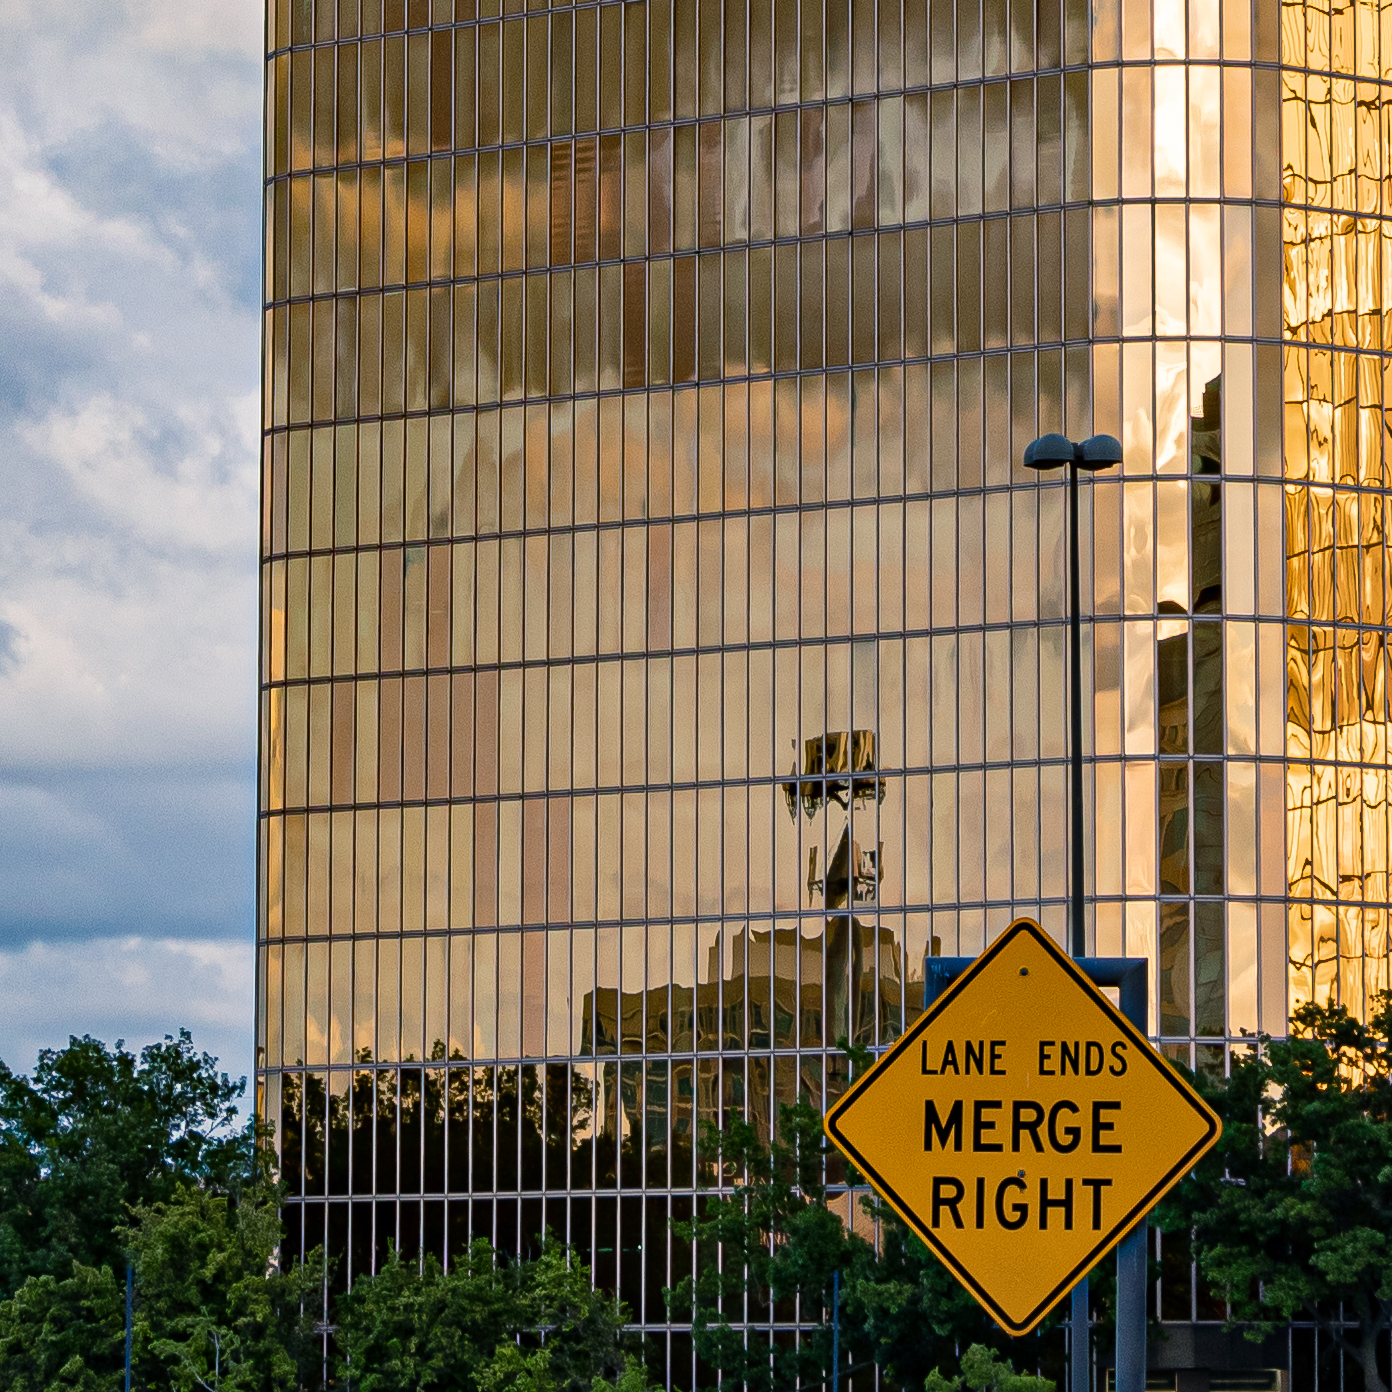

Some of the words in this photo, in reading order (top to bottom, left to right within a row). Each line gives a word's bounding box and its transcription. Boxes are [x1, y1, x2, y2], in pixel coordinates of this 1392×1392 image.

[921, 1039, 1007, 1076] LANE
[1038, 1039, 1128, 1078] ENDS
[923, 1098, 1123, 1154] MERGE
[930, 1175, 1113, 1232] RIGHT
